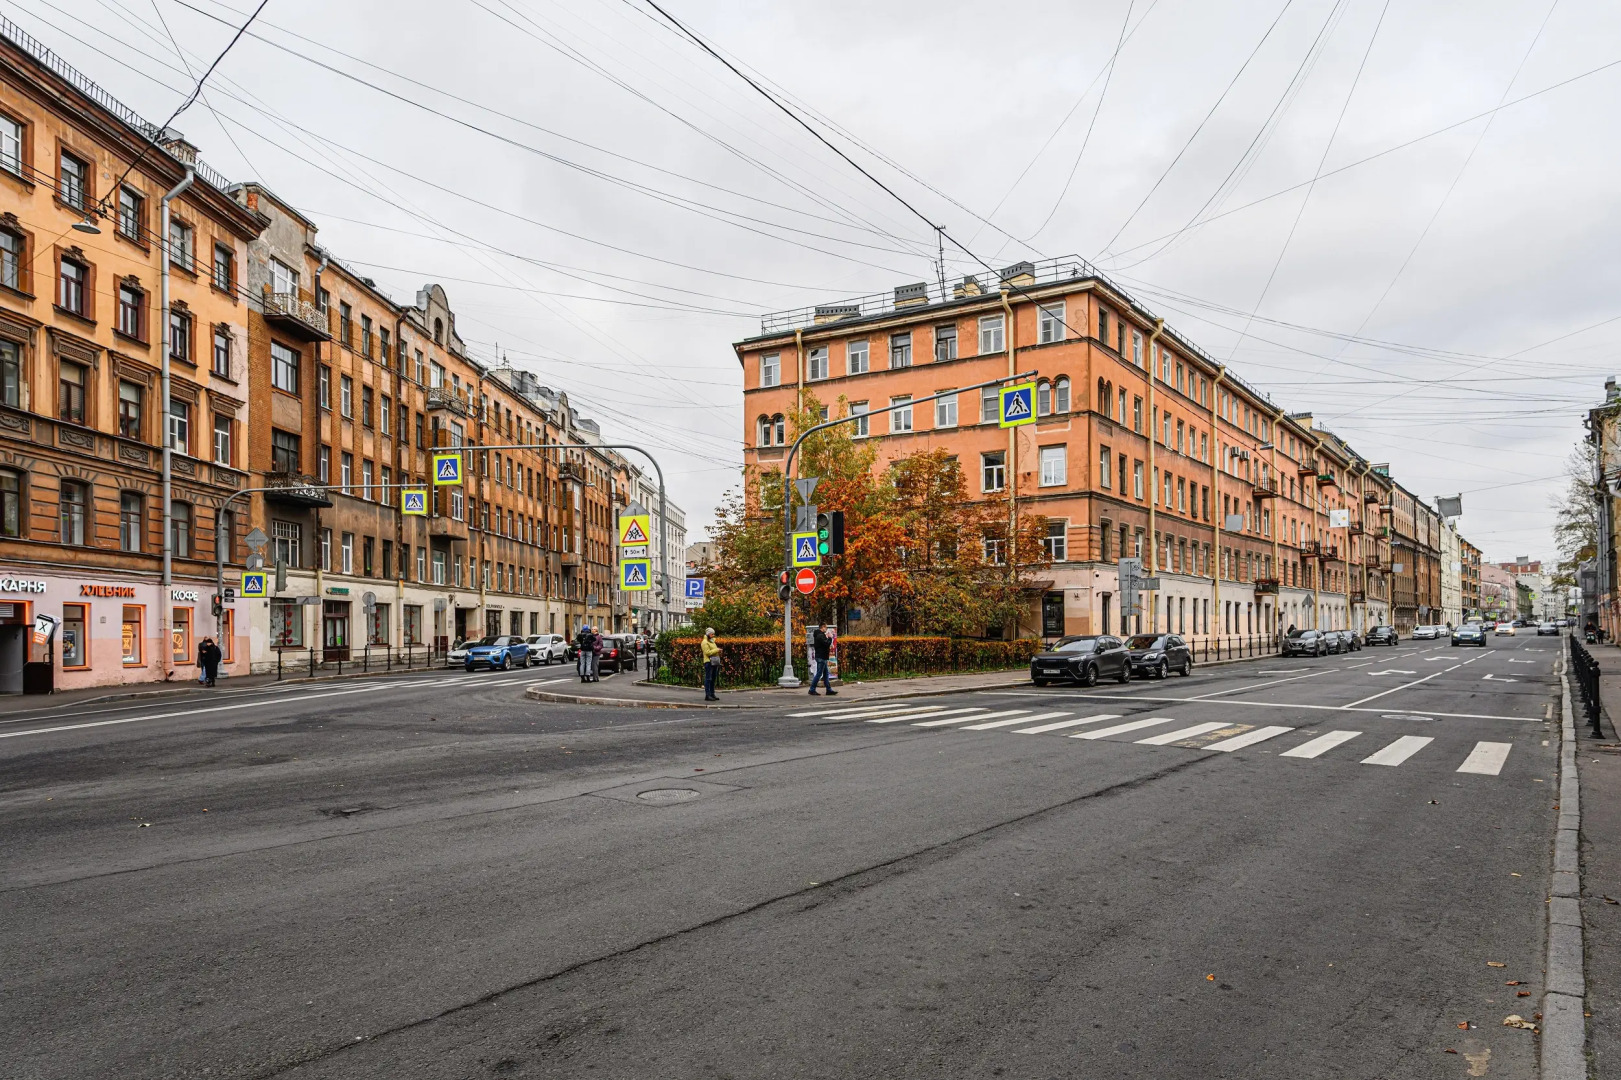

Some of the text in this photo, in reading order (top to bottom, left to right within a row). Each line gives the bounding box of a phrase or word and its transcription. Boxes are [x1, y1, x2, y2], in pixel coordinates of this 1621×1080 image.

[80, 585, 136, 597] ХЛЕБНИК
[690, 580, 700, 595] P
[172, 590, 198, 601] КОФЕ
